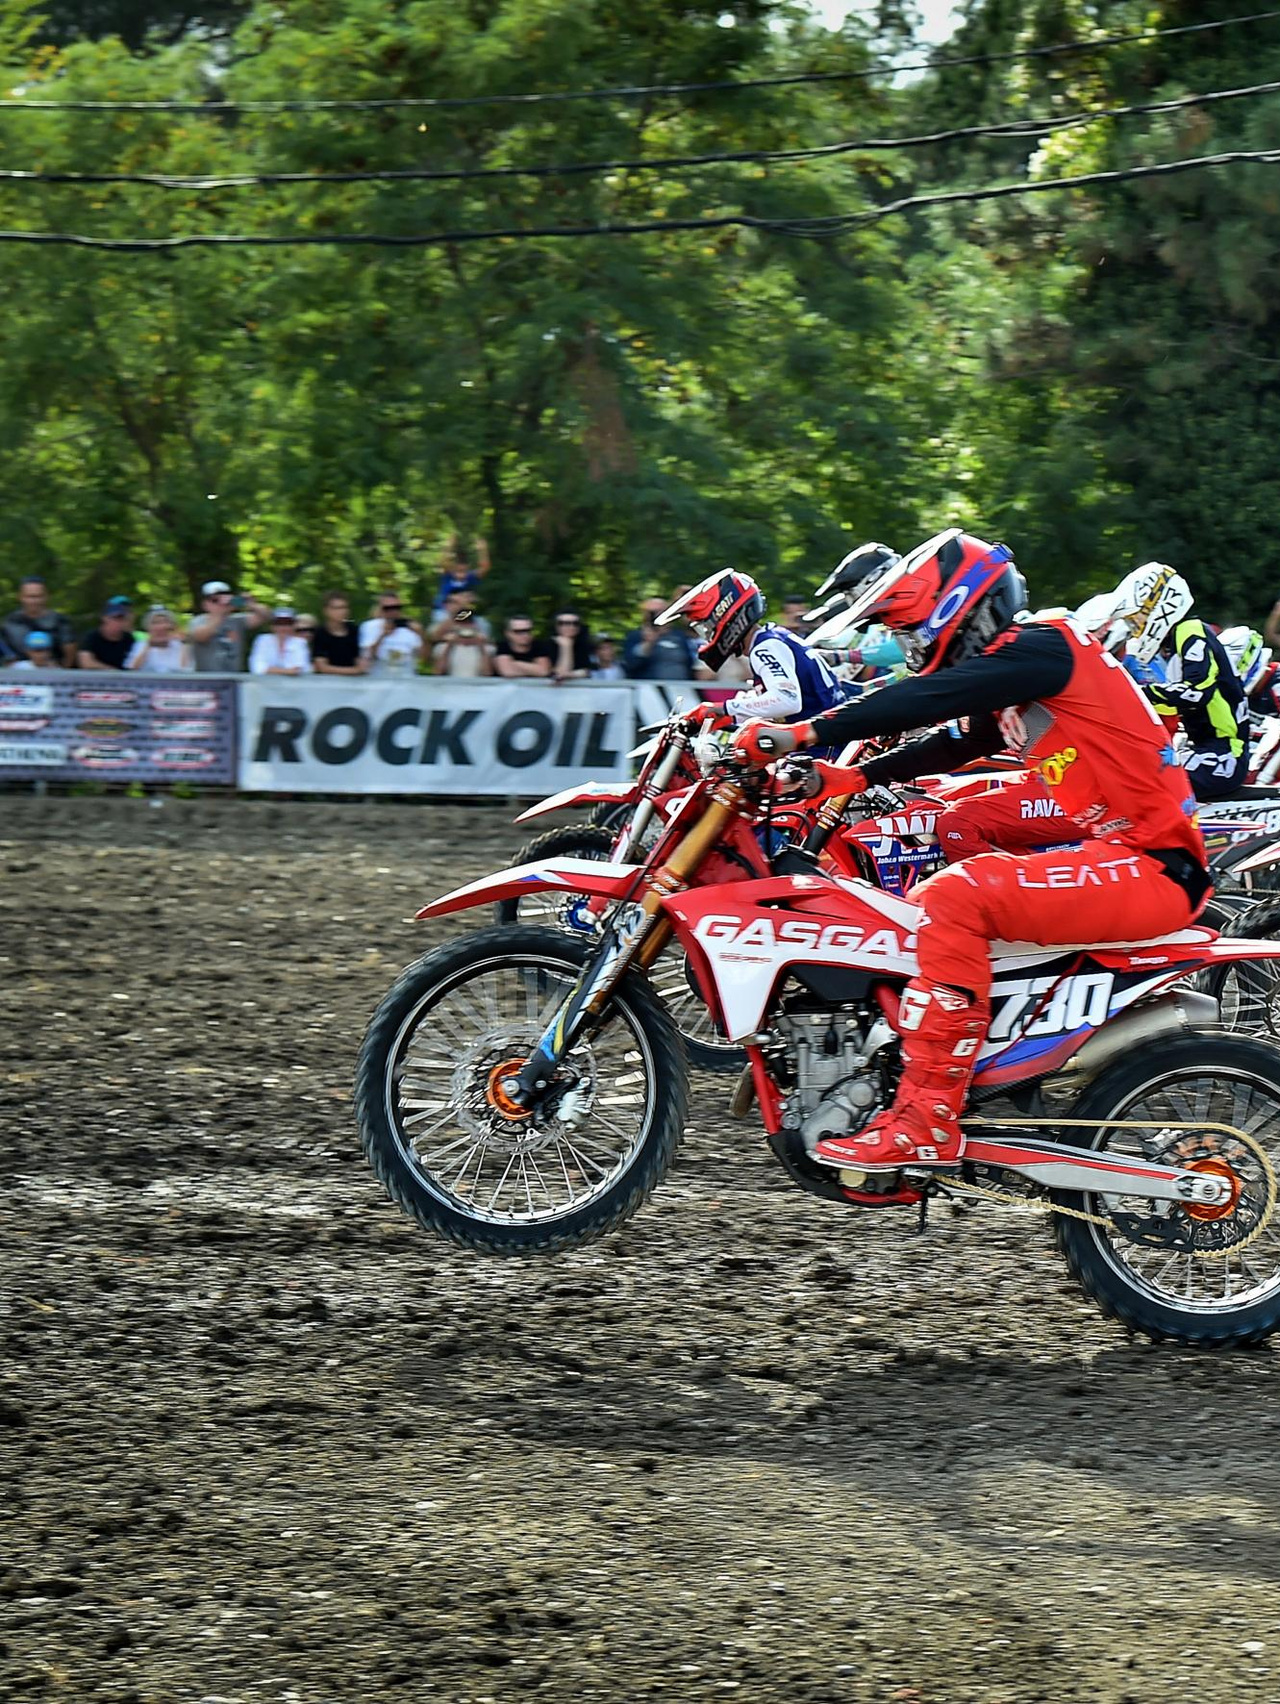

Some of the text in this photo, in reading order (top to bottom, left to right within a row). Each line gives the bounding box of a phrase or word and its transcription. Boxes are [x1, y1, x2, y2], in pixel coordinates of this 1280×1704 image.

[754, 648, 789, 680] LEATT
[252, 706, 624, 768] ROCK OIL
[1019, 799, 1068, 819] RAVE
[1016, 856, 1142, 889] LEATT
[988, 972, 1116, 1042] 730
